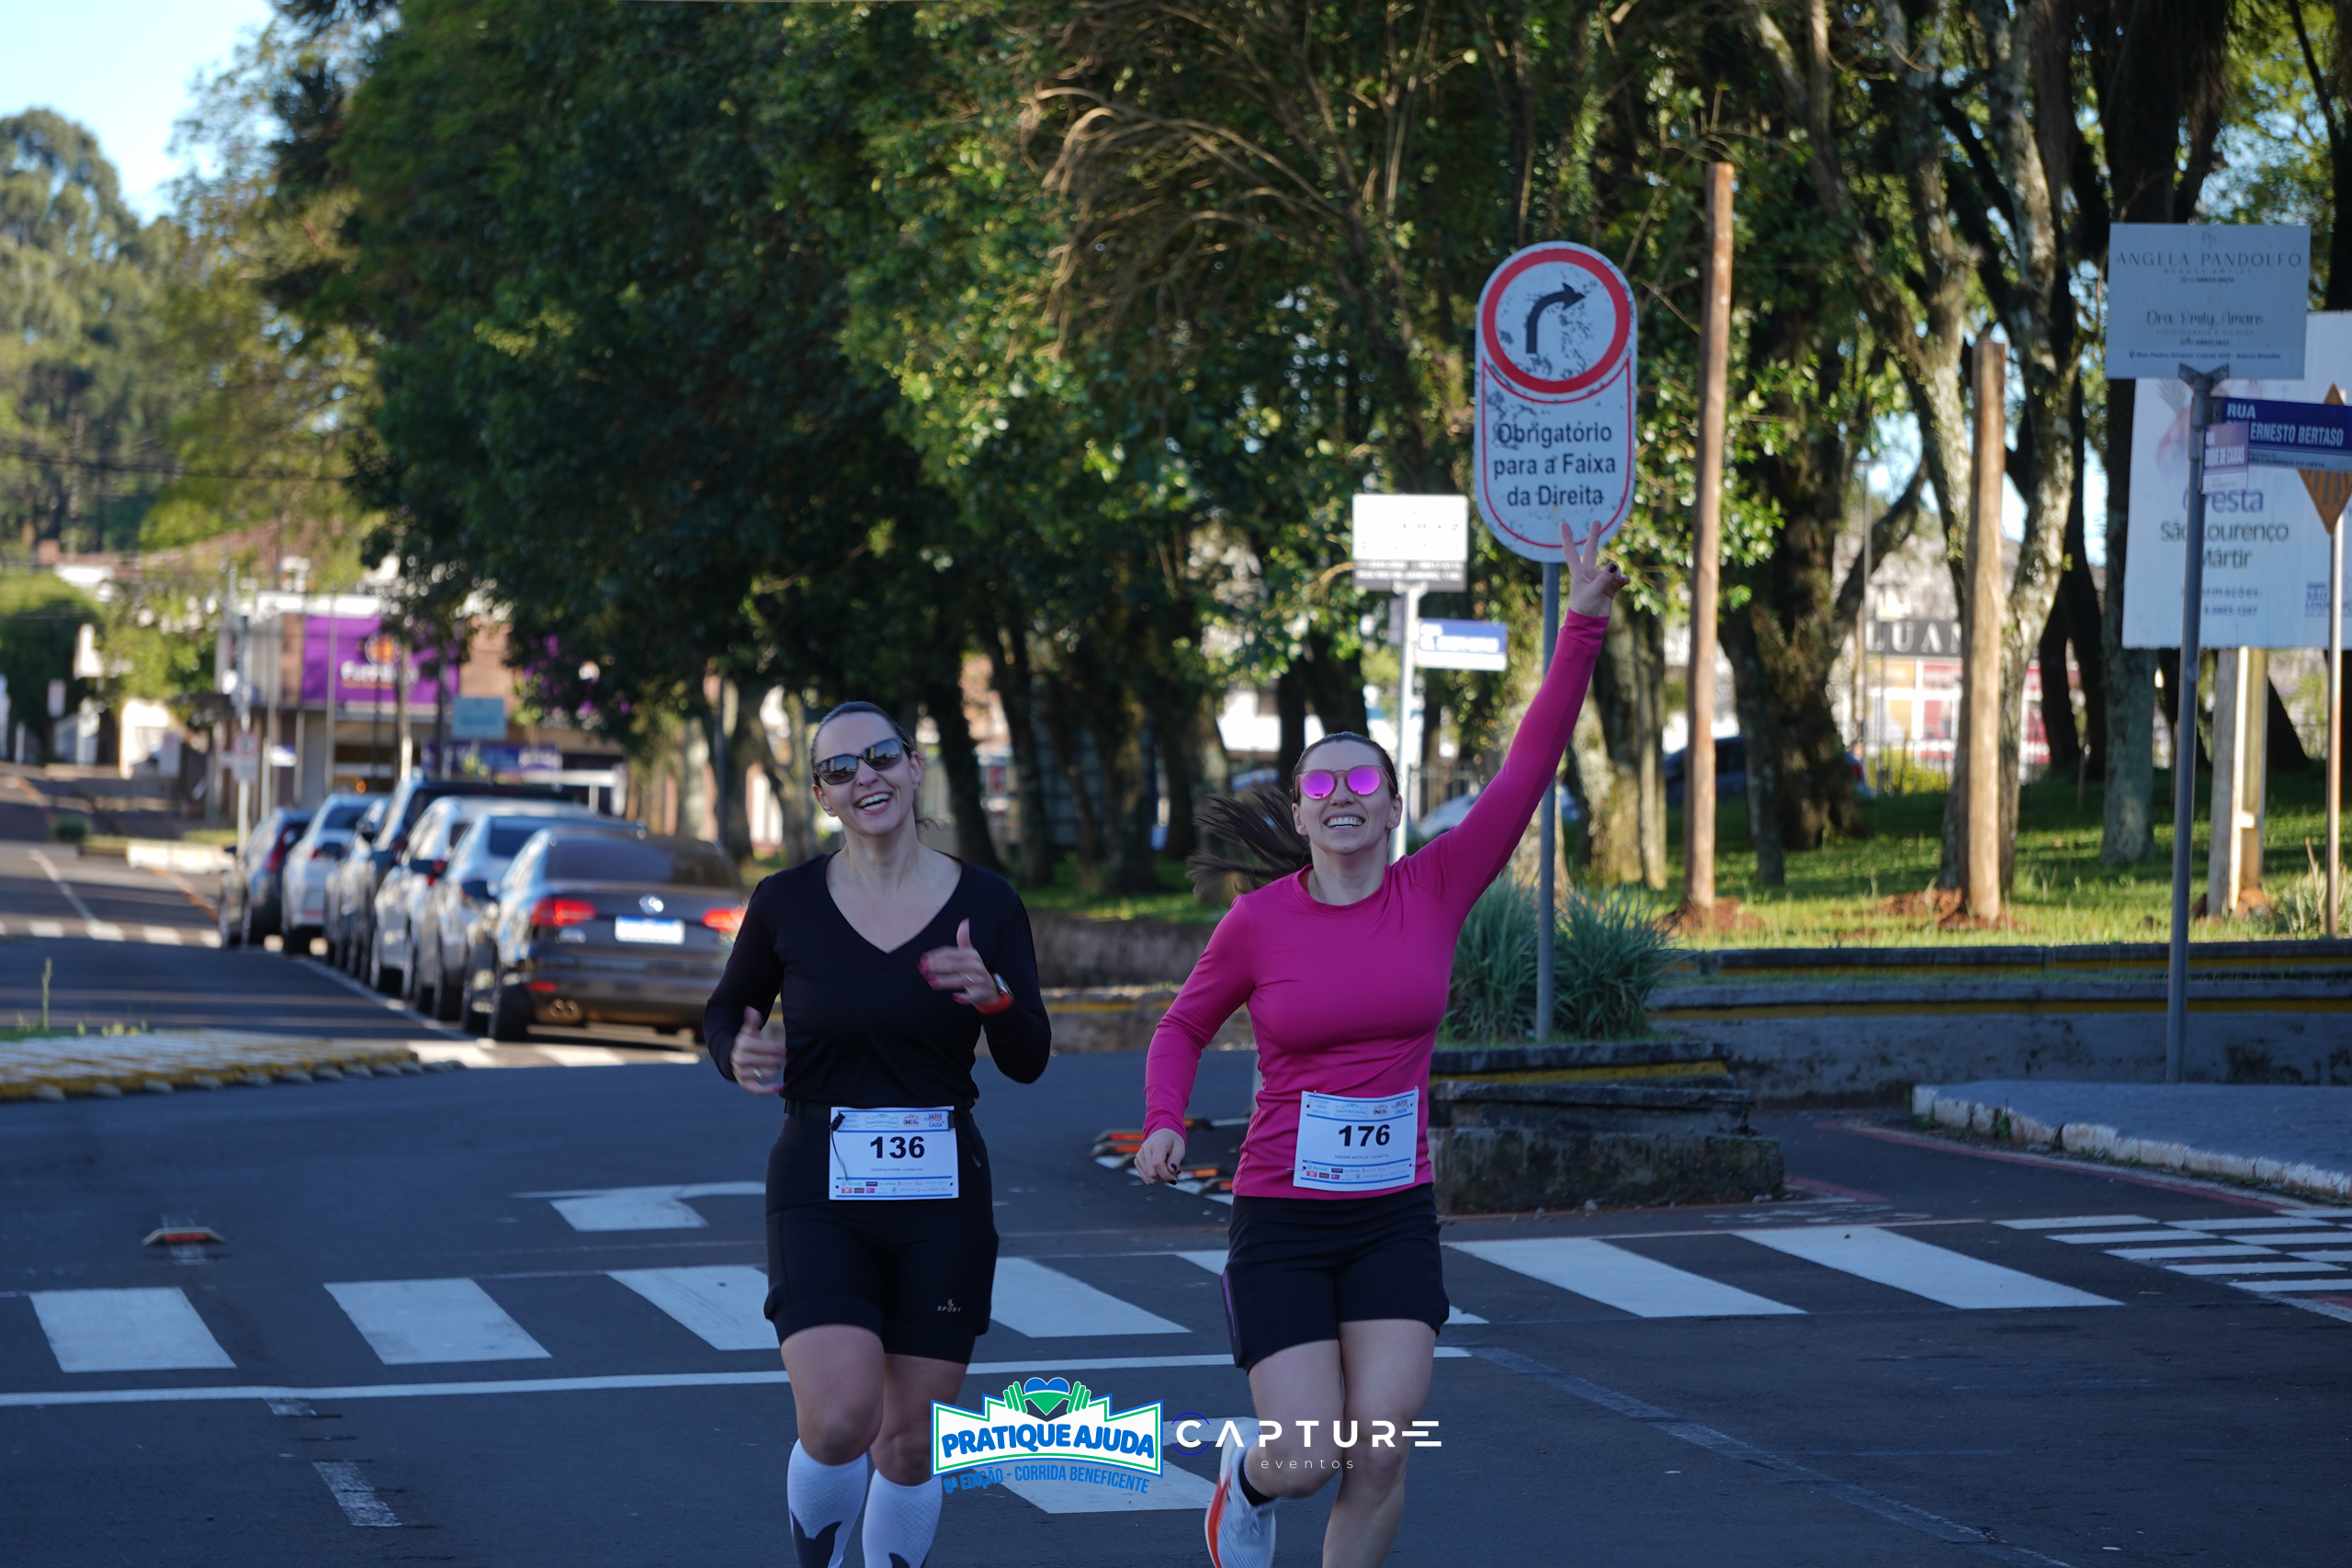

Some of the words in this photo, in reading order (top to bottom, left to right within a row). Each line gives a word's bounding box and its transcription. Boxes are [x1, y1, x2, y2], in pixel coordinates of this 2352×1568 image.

[2116, 251, 2189, 266] ANGELA
[2200, 252, 2302, 268] PANDOLFO
[2226, 401, 2256, 420] RUA
[1498, 422, 1612, 448] Obrigatório
[2250, 421, 2296, 445] ERNESTO
[2297, 424, 2345, 447] BERTASO
[1494, 458, 1537, 479] para
[1544, 458, 1555, 475] a
[1563, 453, 1616, 475] Faixa
[1507, 486, 1531, 506] da
[1538, 485, 1603, 506] Direita
[2203, 523, 2290, 545] ourenço
[870, 1135, 925, 1159] 136
[1339, 1123, 1391, 1147] 176
